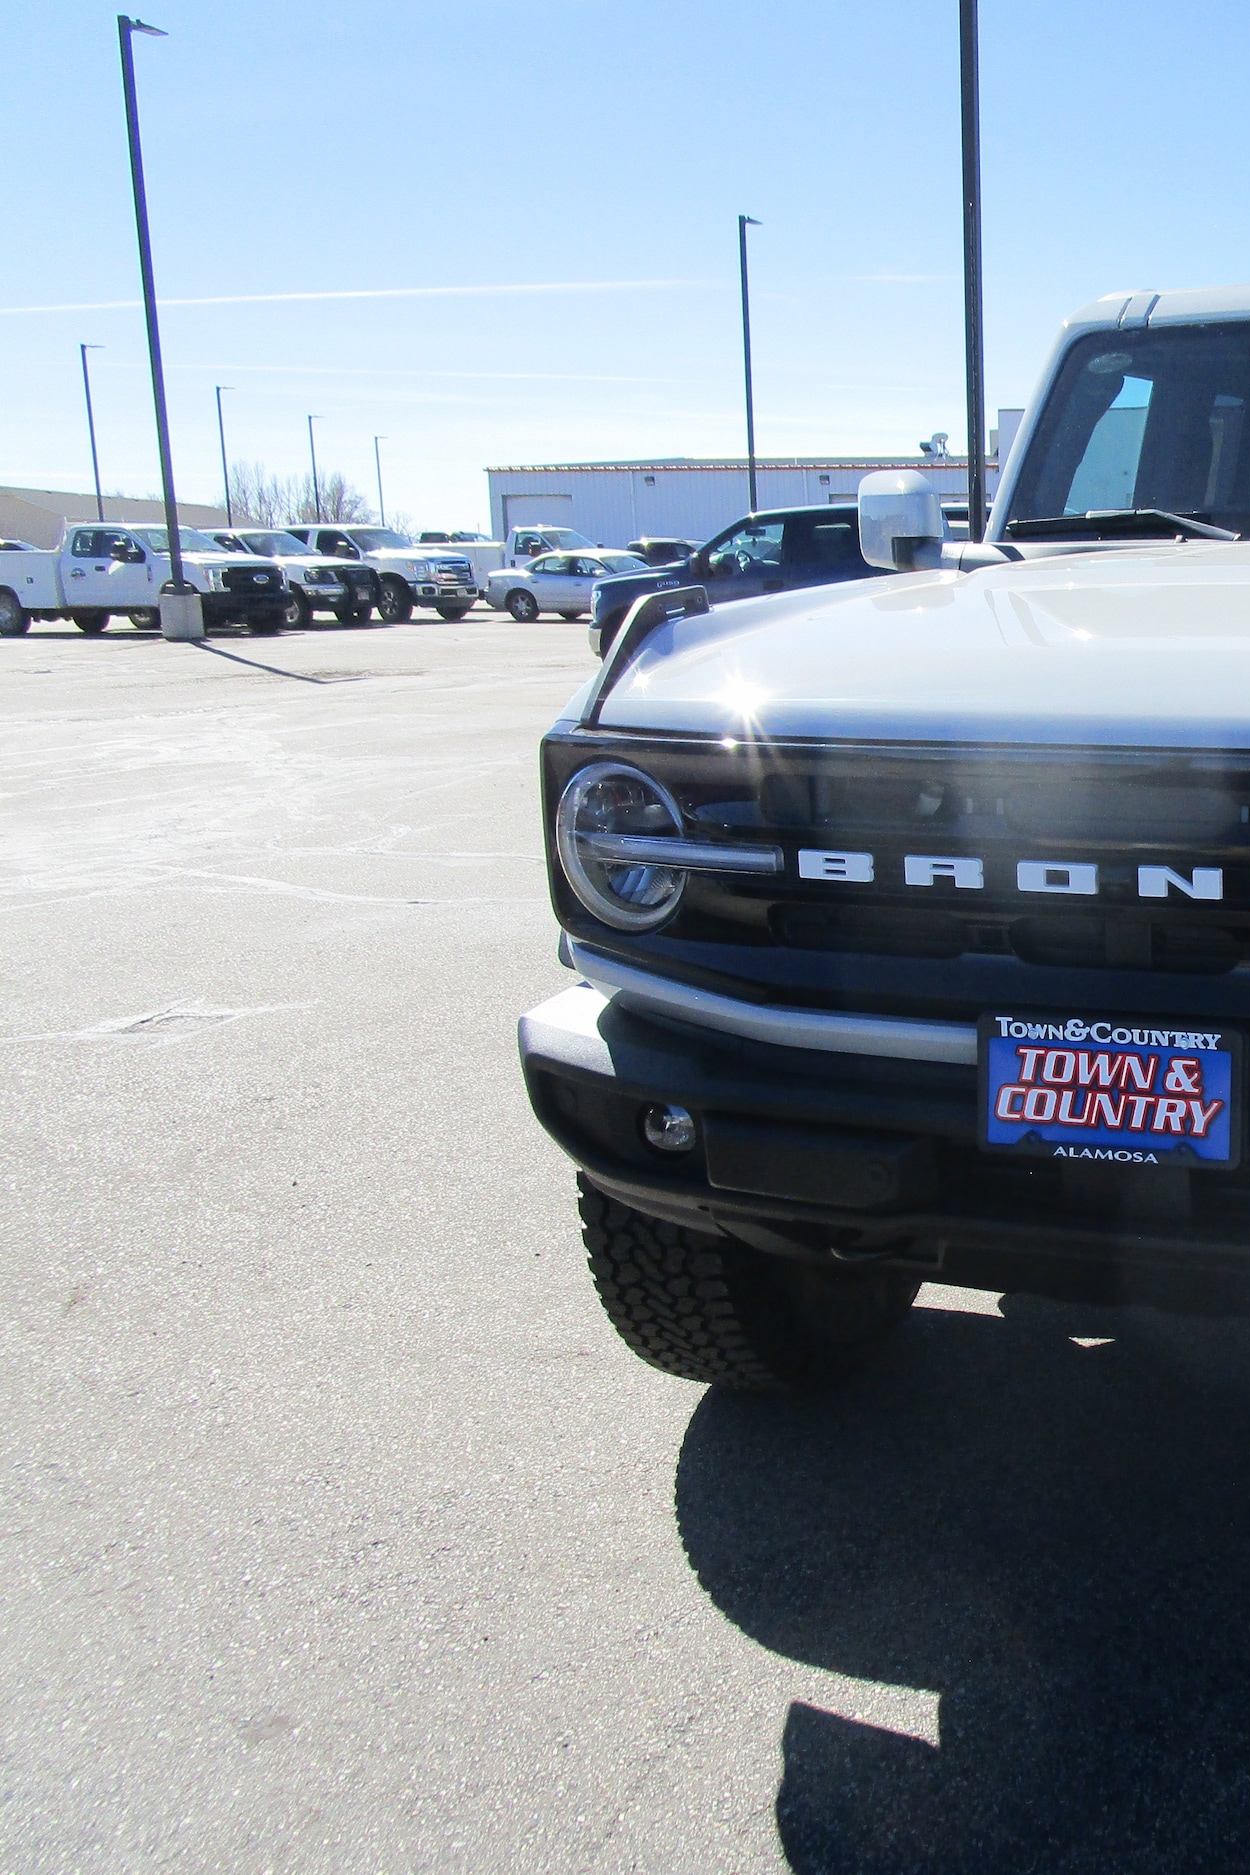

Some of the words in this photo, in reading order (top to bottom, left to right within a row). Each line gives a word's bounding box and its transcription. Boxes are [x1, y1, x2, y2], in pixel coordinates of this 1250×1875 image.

[1017, 1046, 1157, 1091] TOWN
[1165, 1057, 1202, 1094] &
[995, 1084, 1222, 1136] COUNTRY
[1053, 1145, 1159, 1165] ALAMOSA
